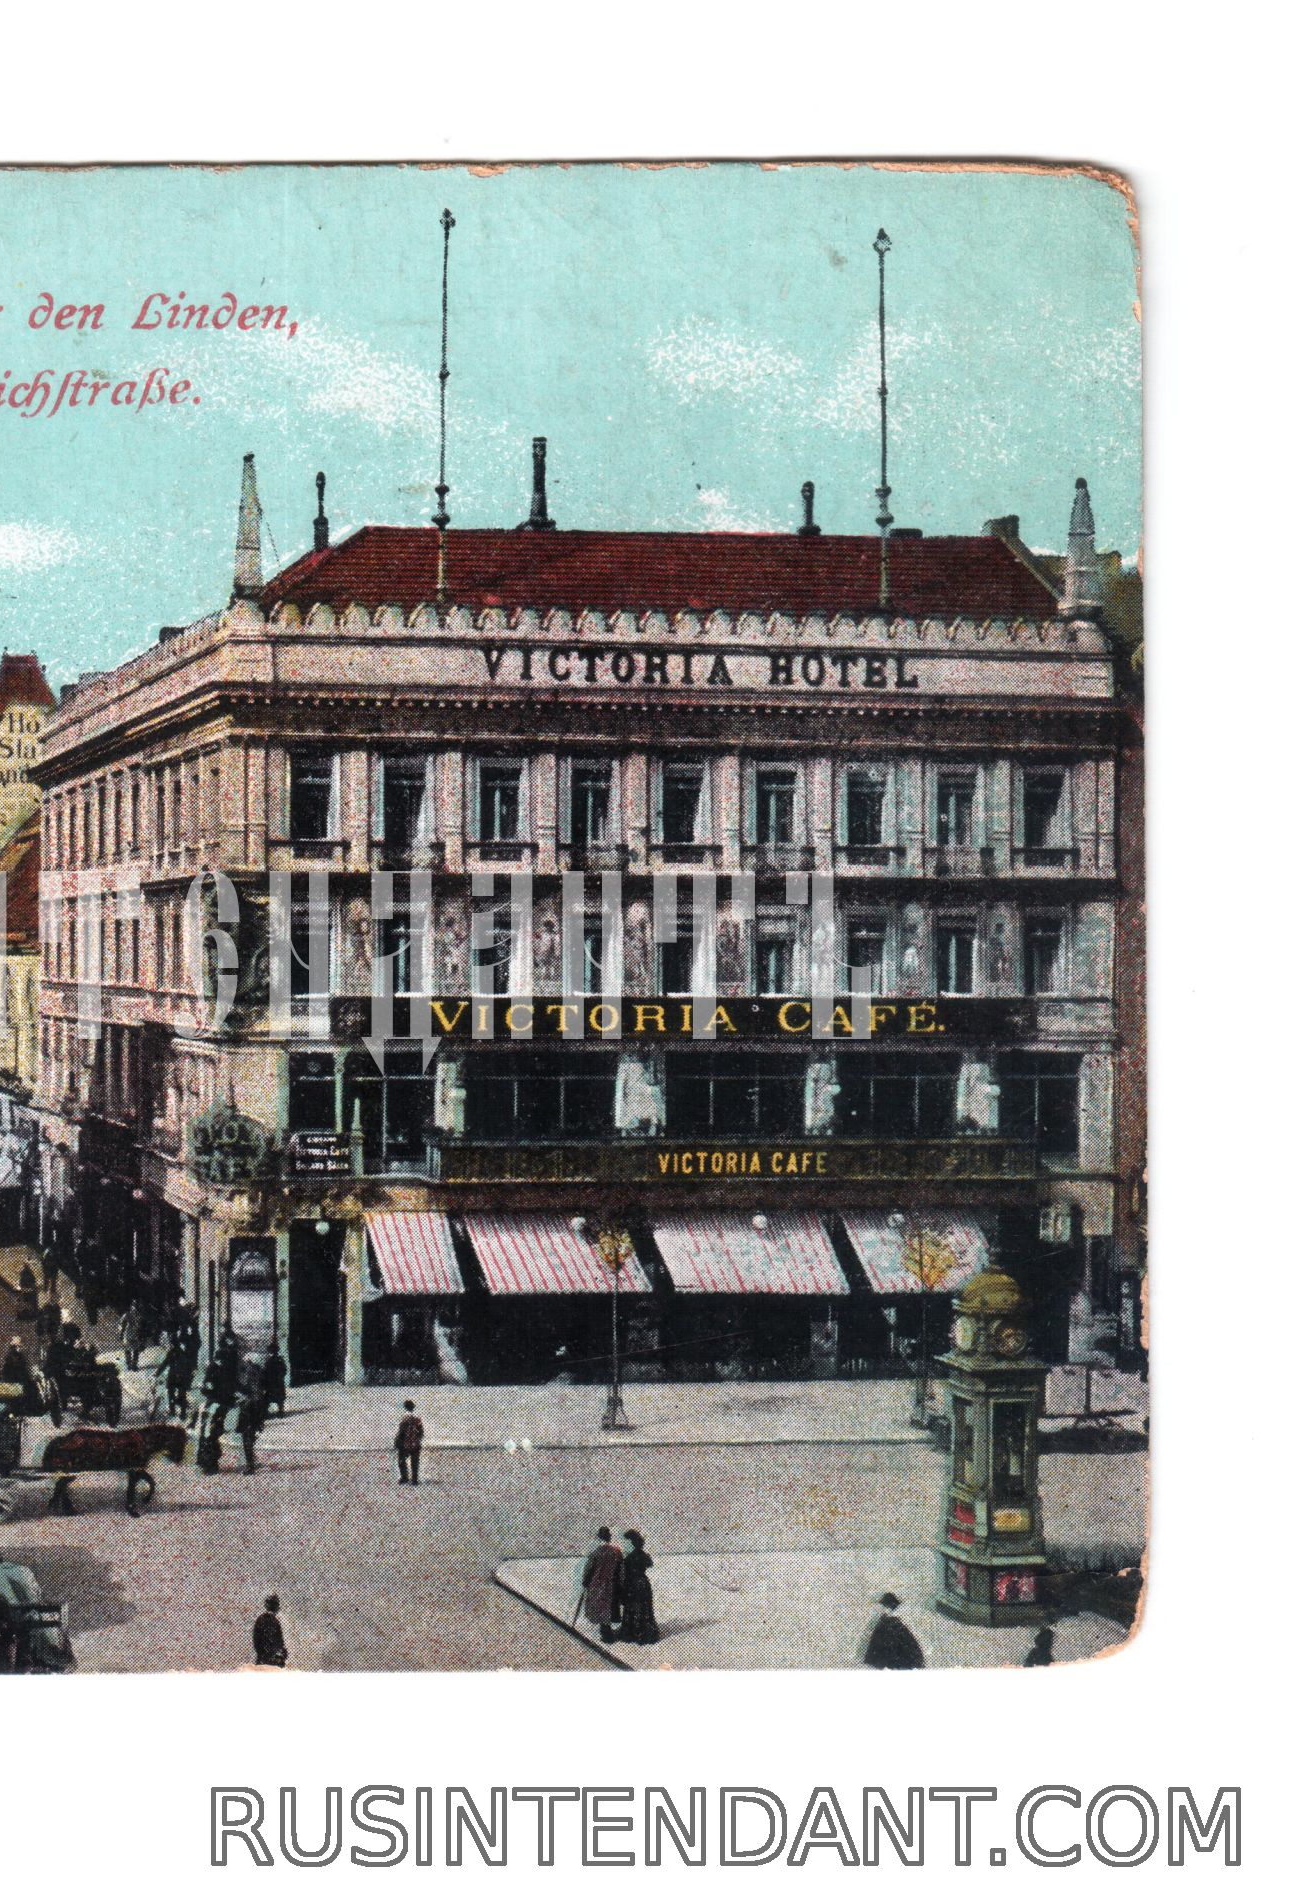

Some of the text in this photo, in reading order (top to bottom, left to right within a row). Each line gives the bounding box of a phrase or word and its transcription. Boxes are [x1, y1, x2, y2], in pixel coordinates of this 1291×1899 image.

[28, 292, 104, 330] den
[132, 292, 300, 336] Linden,
[482, 648, 919, 689] VICTORIA HOTEL
[429, 1000, 736, 1032] VICTORIA
[657, 1151, 827, 1175] VICTORIA CAFE
